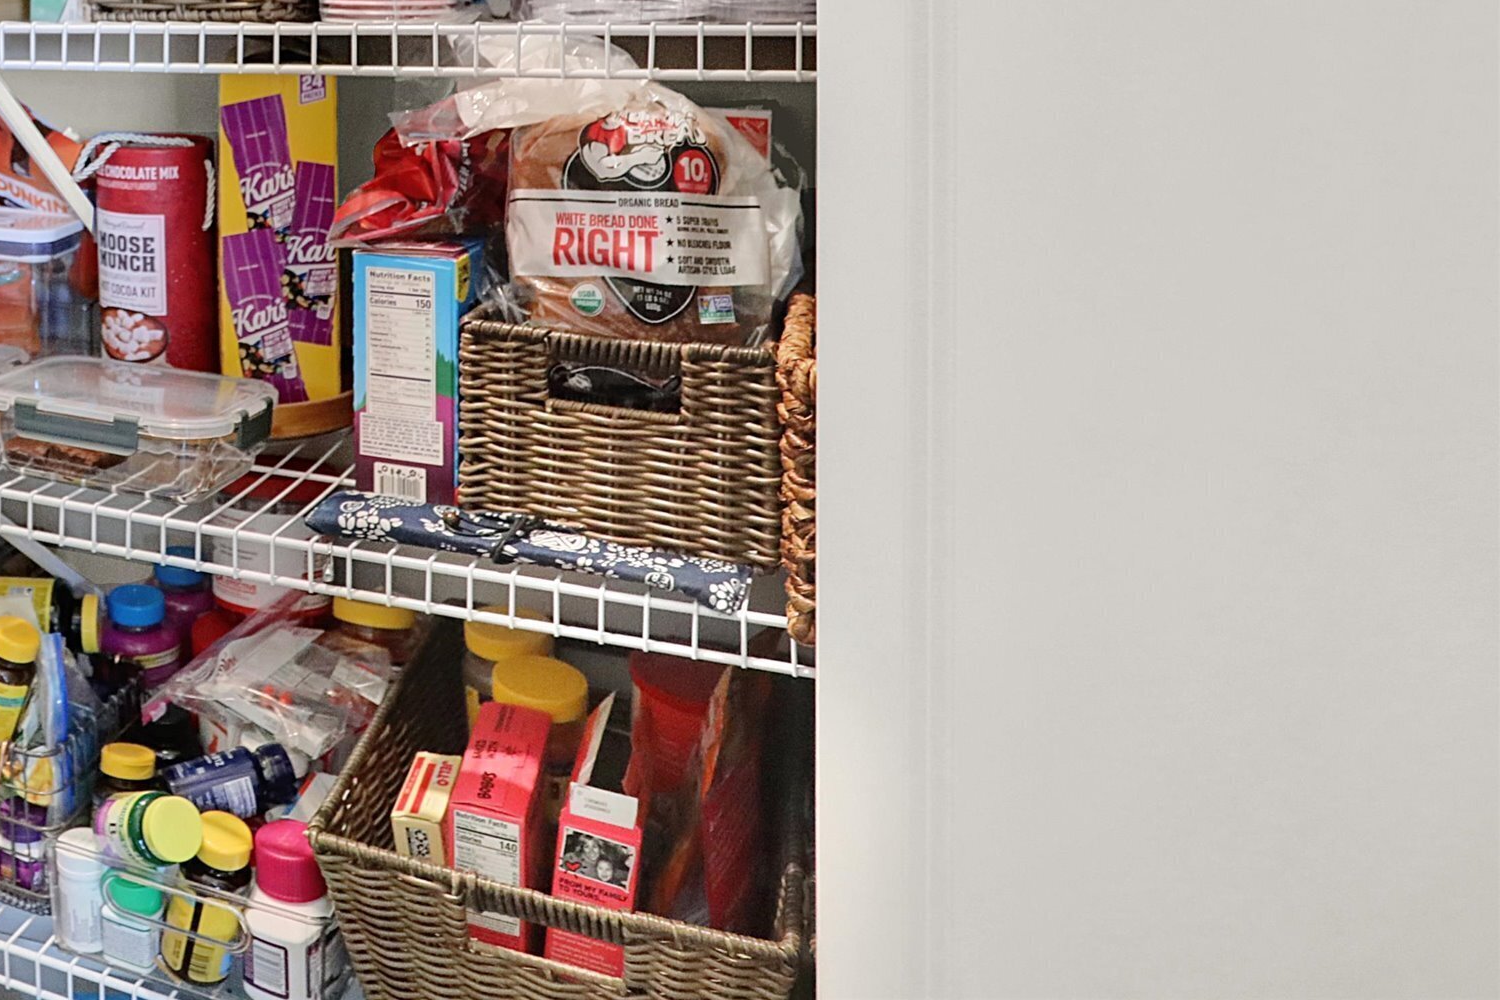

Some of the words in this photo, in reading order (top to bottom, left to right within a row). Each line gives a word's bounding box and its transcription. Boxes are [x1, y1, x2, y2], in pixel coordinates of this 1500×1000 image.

[302, 75, 324, 91] 24
[107, 165, 157, 180] CHOCOLATE
[159, 166, 180, 180] MIX
[240, 165, 295, 207] Kar's
[618, 198, 652, 208] ORGANIC
[654, 199, 680, 208] BREAD
[555, 212, 586, 227] WHITE
[589, 214, 625, 229] BREAD
[628, 215, 658, 230] DONE
[101, 236, 156, 254] MOOSE
[553, 227, 659, 273] RIGHT
[101, 251, 156, 273] MUNCH
[370, 271, 406, 280] Nutrition
[408, 274, 431, 282] Facts
[111, 283, 138, 297] COCOA
[140, 286, 156, 298] KIT
[370, 298, 397, 307] Calories
[415, 300, 432, 309] 150
[232, 298, 288, 338] Kar's
[455, 811, 487, 824] Nutrition
[488, 819, 508, 830] Facts
[500, 841, 518, 853] 140
